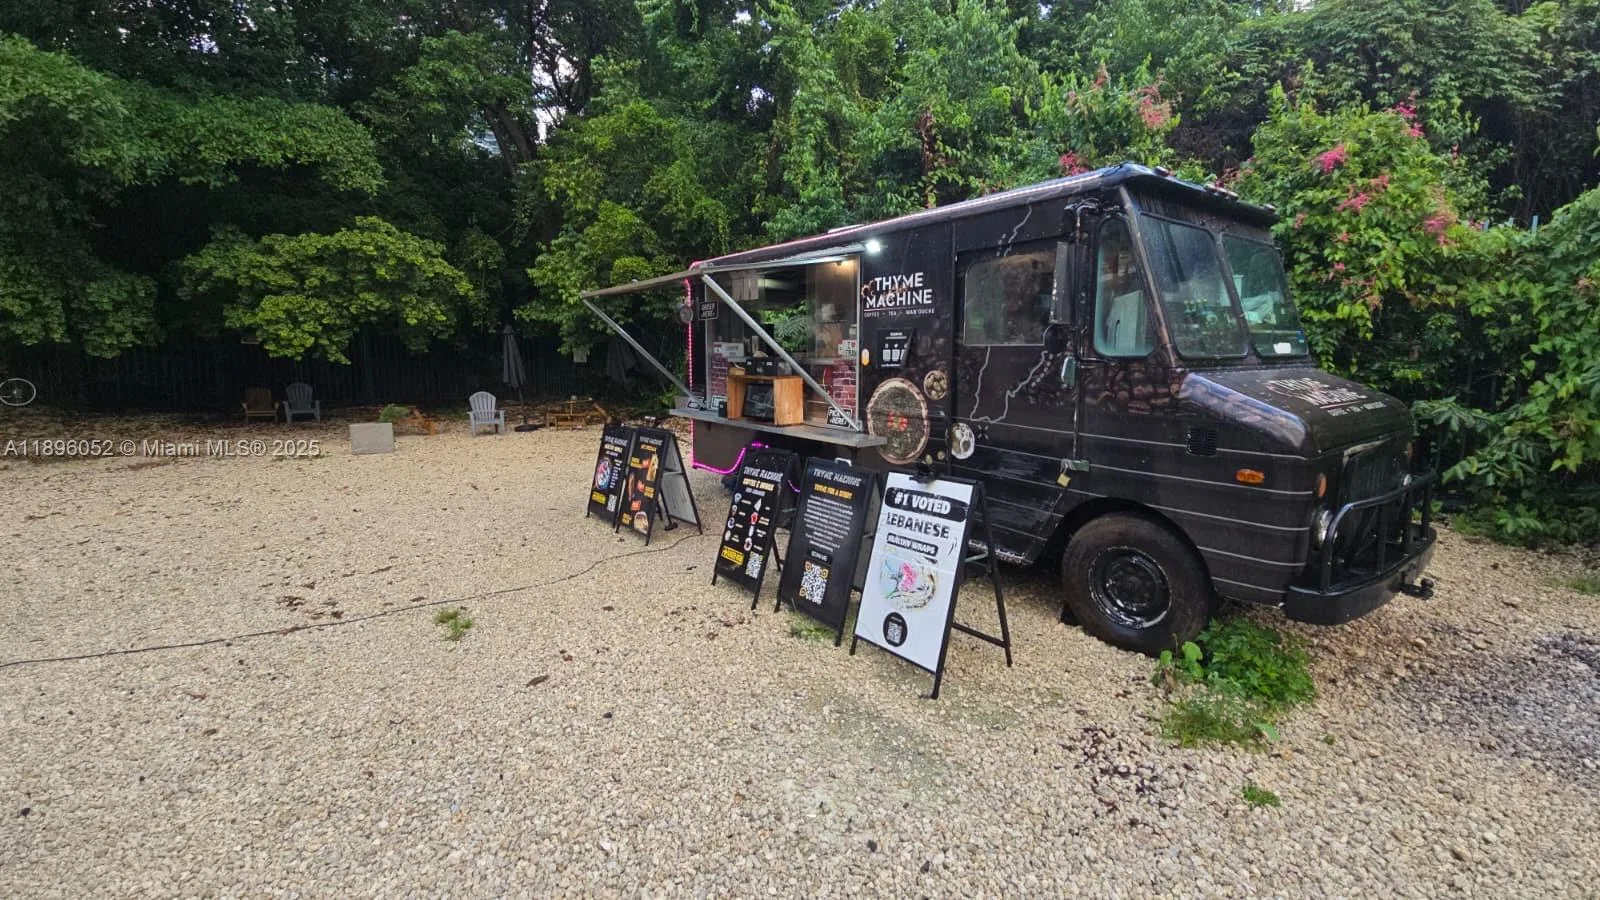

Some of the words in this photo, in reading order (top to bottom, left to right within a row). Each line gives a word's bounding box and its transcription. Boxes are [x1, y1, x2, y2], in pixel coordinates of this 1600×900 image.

[874, 272, 924, 291] THYME
[866, 289, 933, 308] MACHINE
[894, 491, 909, 506] #1
[911, 494, 951, 515] VOTED
[886, 512, 950, 539] LEBANESE
[910, 541, 936, 555] WRAPS
